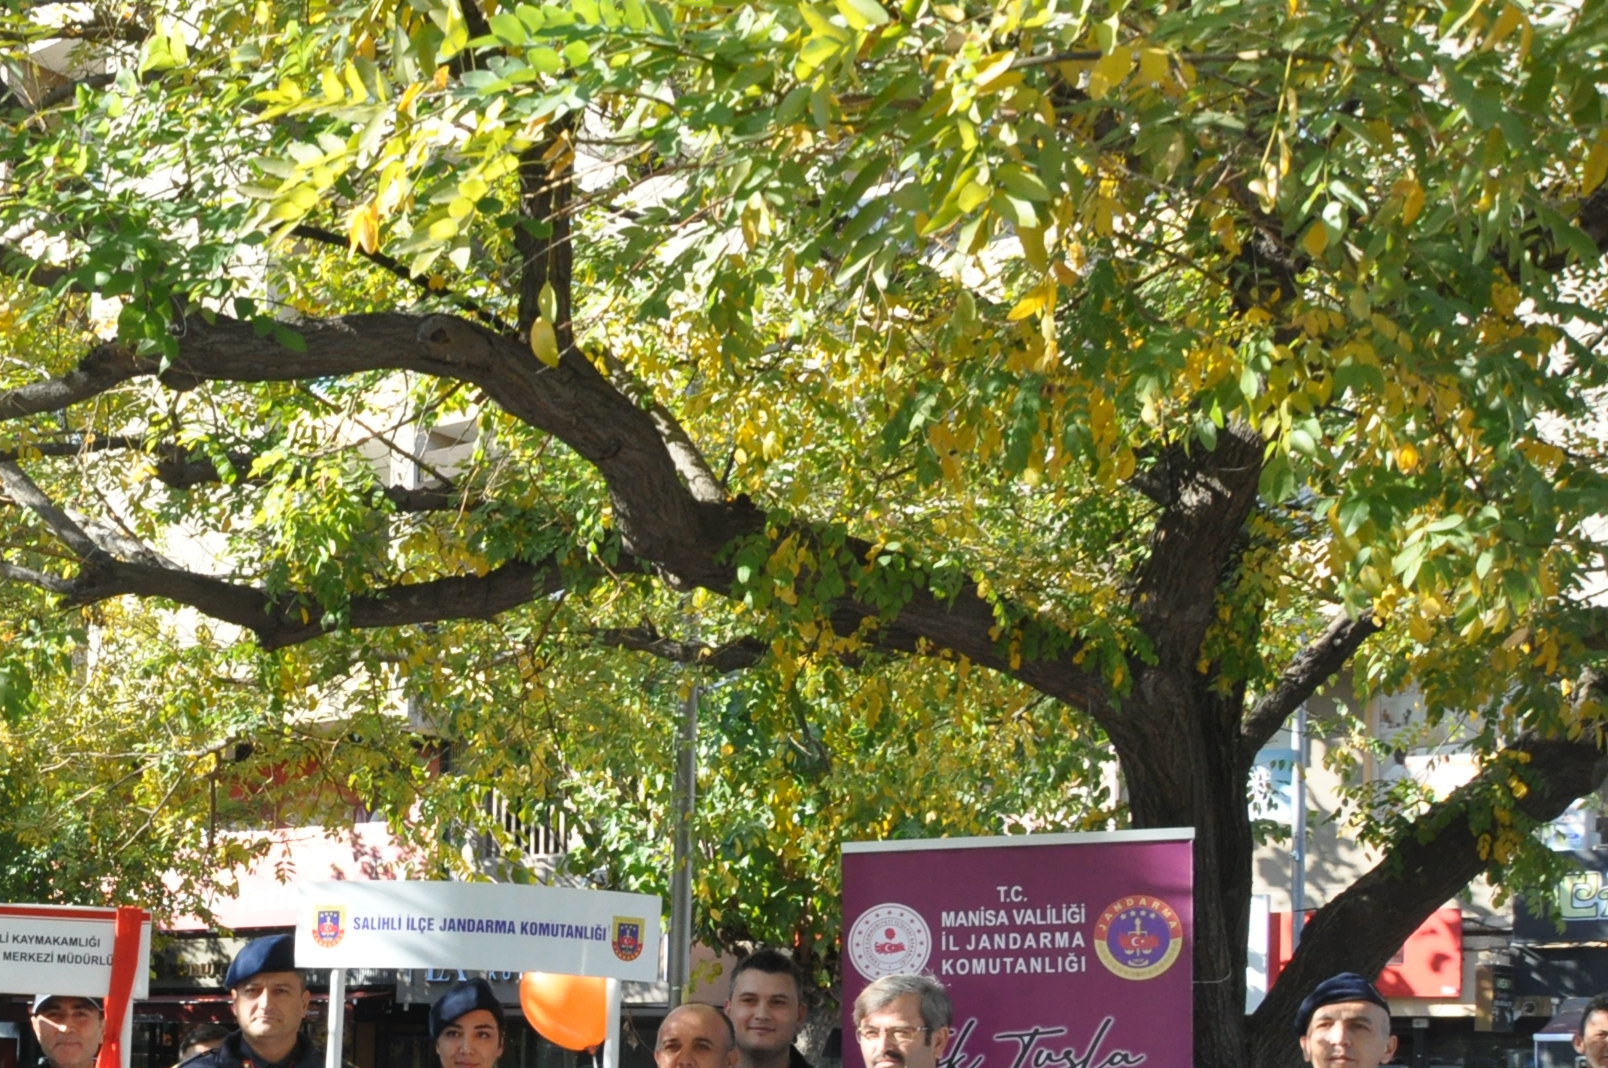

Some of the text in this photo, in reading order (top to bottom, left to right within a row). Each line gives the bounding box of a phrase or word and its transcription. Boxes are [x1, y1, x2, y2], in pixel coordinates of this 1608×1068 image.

[997, 886, 1027, 902] T.C.
[942, 903, 1086, 927] MANİSA VALİLİĞİ
[1099, 898, 1177, 931] JANDARMA
[353, 914, 607, 941] SALİHLİ İLÇE JANDARMA KOMUTANLIĞI
[12, 932, 101, 948] KAYMAKAMLIĞI
[942, 932, 1085, 951] İL JANDARMA
[3, 950, 54, 963] MERKEZİ
[57, 952, 113, 966] MÜDÜRLÜ
[942, 954, 1086, 975] KOMUTANLIĞI
